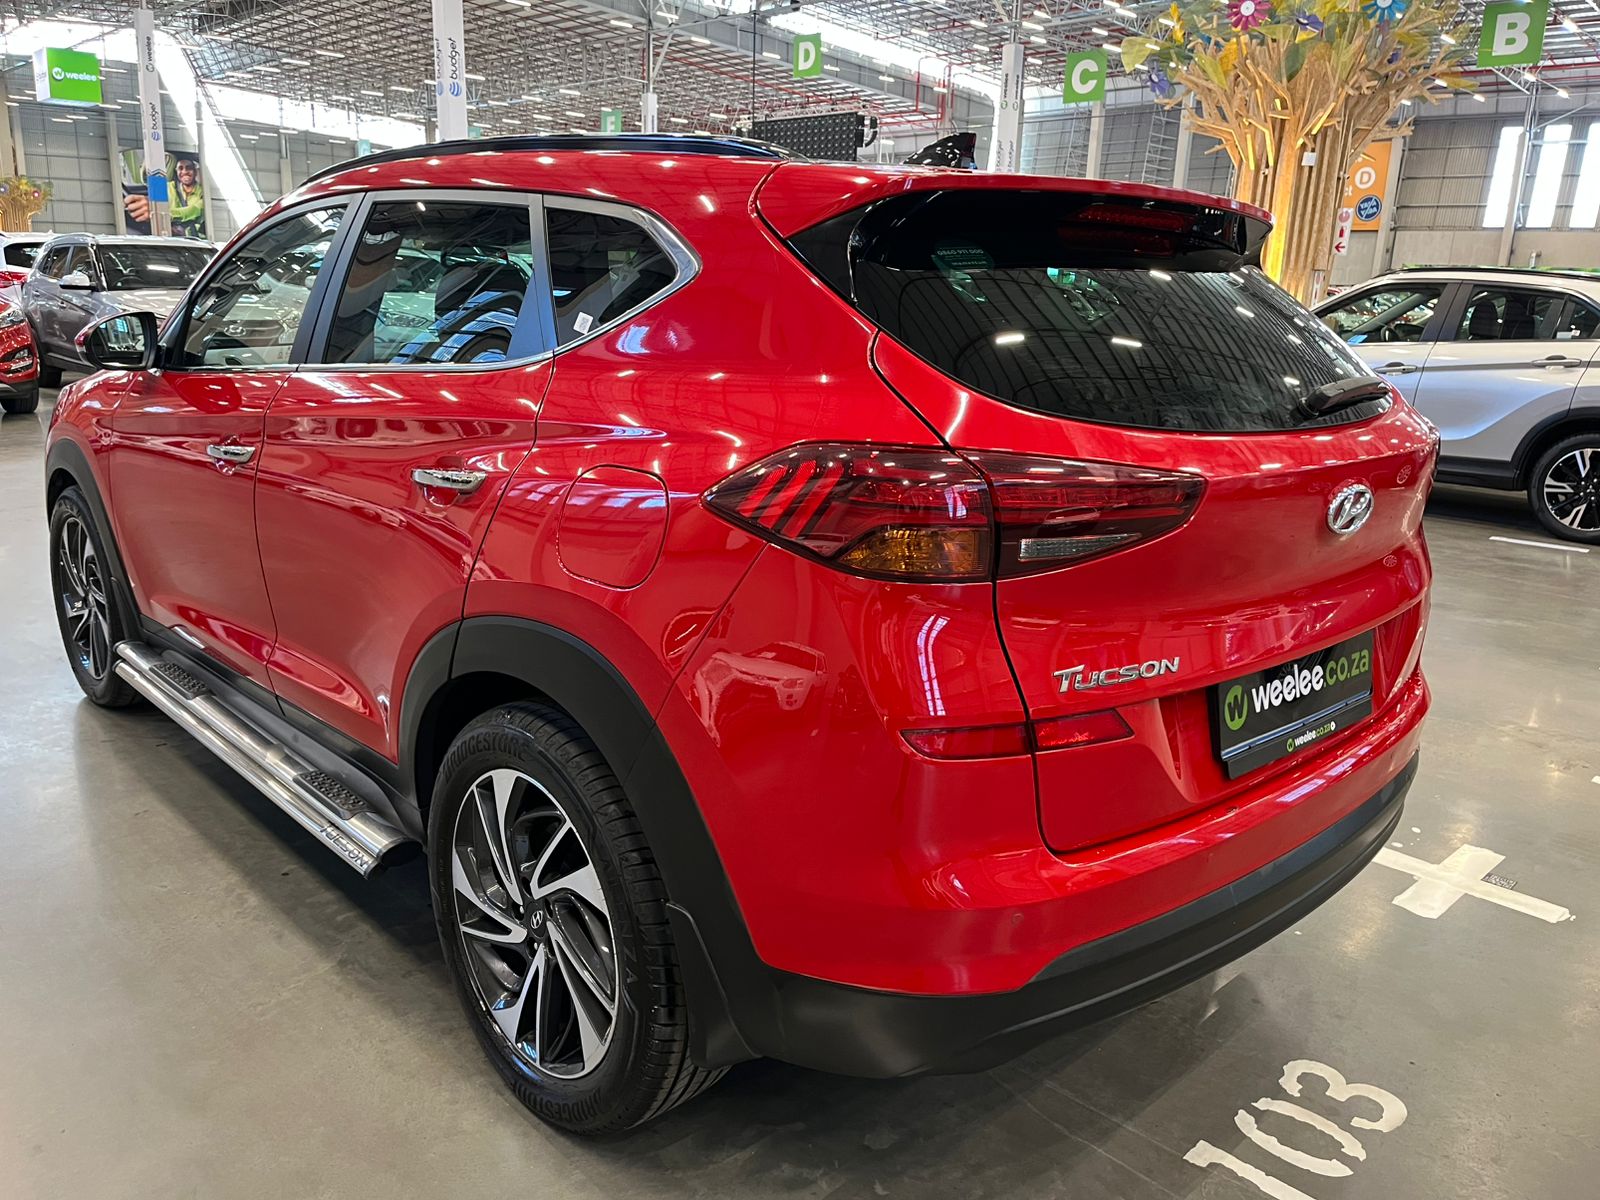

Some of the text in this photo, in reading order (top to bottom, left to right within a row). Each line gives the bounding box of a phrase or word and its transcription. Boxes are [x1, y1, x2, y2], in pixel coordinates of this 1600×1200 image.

[1492, 12, 1531, 56] B
[448, 37, 461, 79] budget
[798, 41, 816, 70] D
[65, 72, 97, 82] weelee
[1072, 59, 1098, 94] C
[149, 102, 159, 130] budget
[1360, 170, 1371, 185] D
[1052, 656, 1180, 693] TUCSON
[1252, 649, 1369, 713] weelee.co.za
[1182, 1060, 1408, 1200] 103
